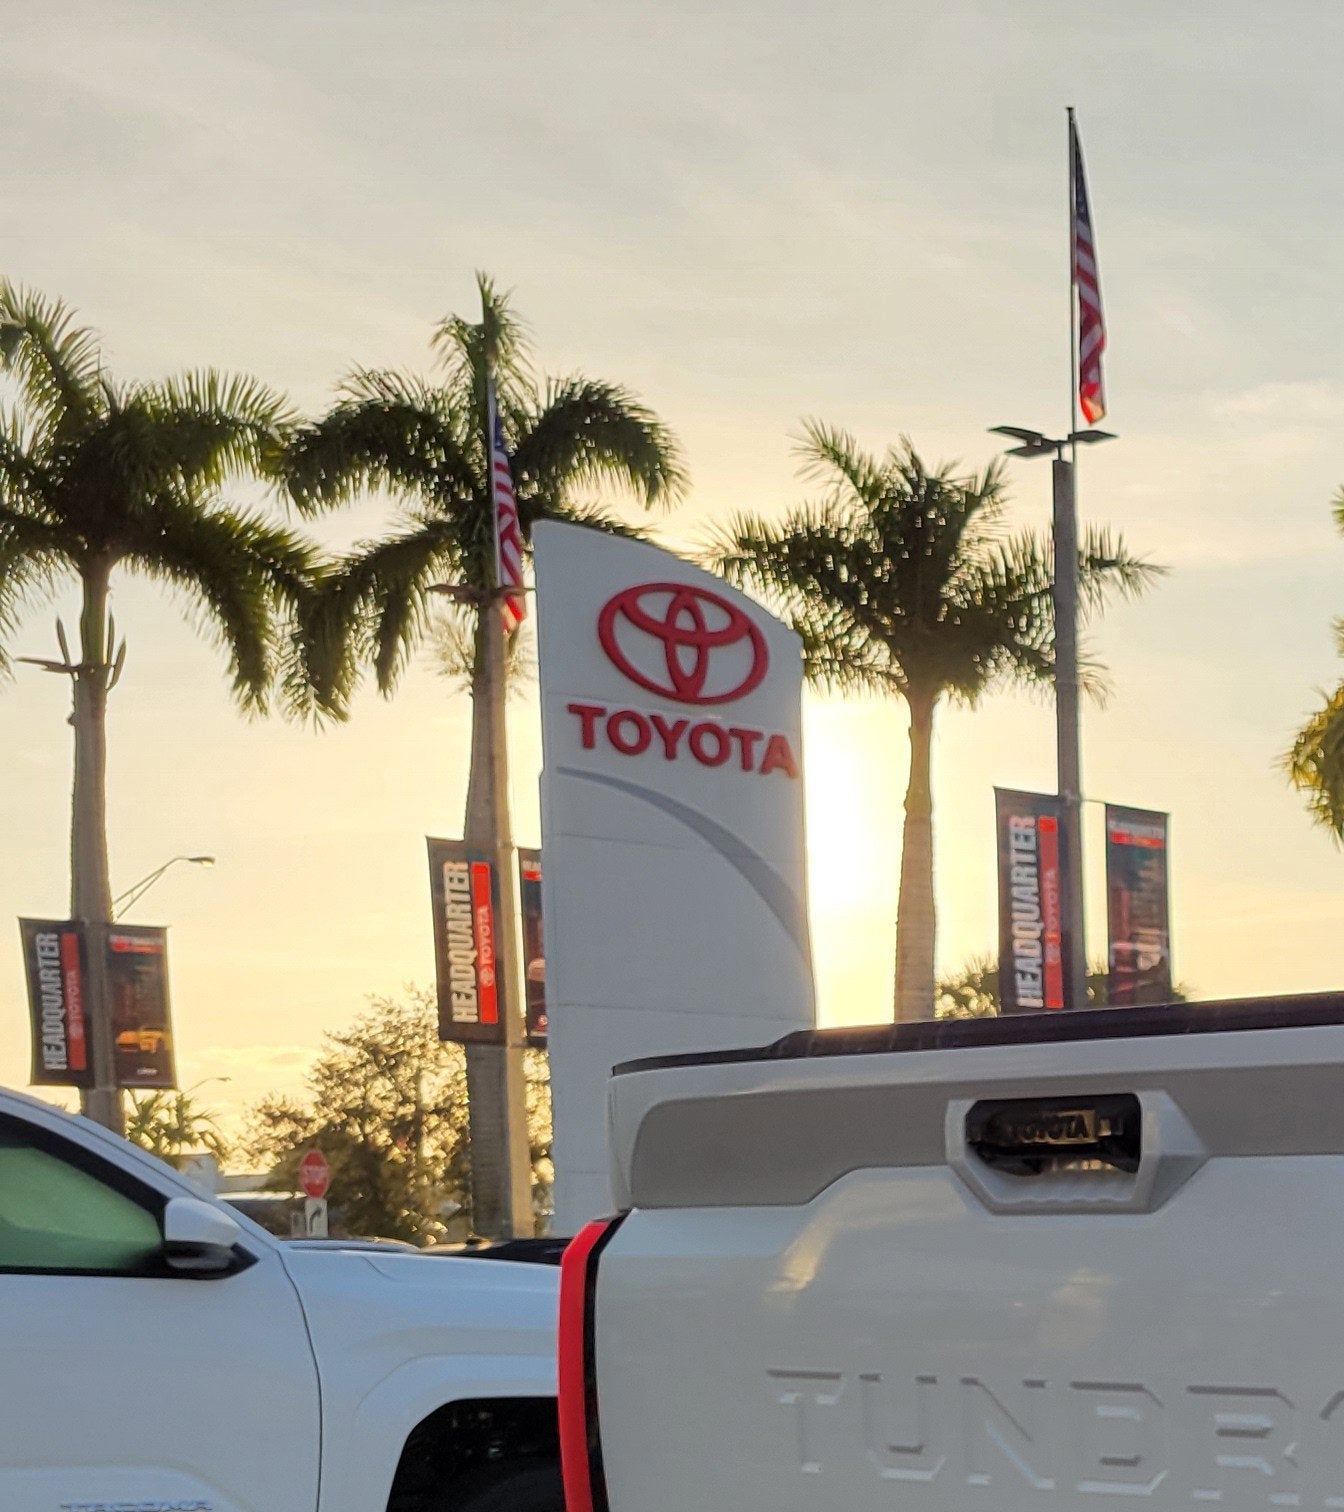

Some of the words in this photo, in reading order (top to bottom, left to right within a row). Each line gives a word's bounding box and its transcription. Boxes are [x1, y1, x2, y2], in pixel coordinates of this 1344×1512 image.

[568, 702, 798, 778] TOYOTA
[443, 861, 479, 1024] HEADQUARTER
[476, 905, 494, 965] TOYOTA
[1008, 815, 1044, 1009] HEADQUARTER
[35, 932, 67, 1071] HEADQUARTER
